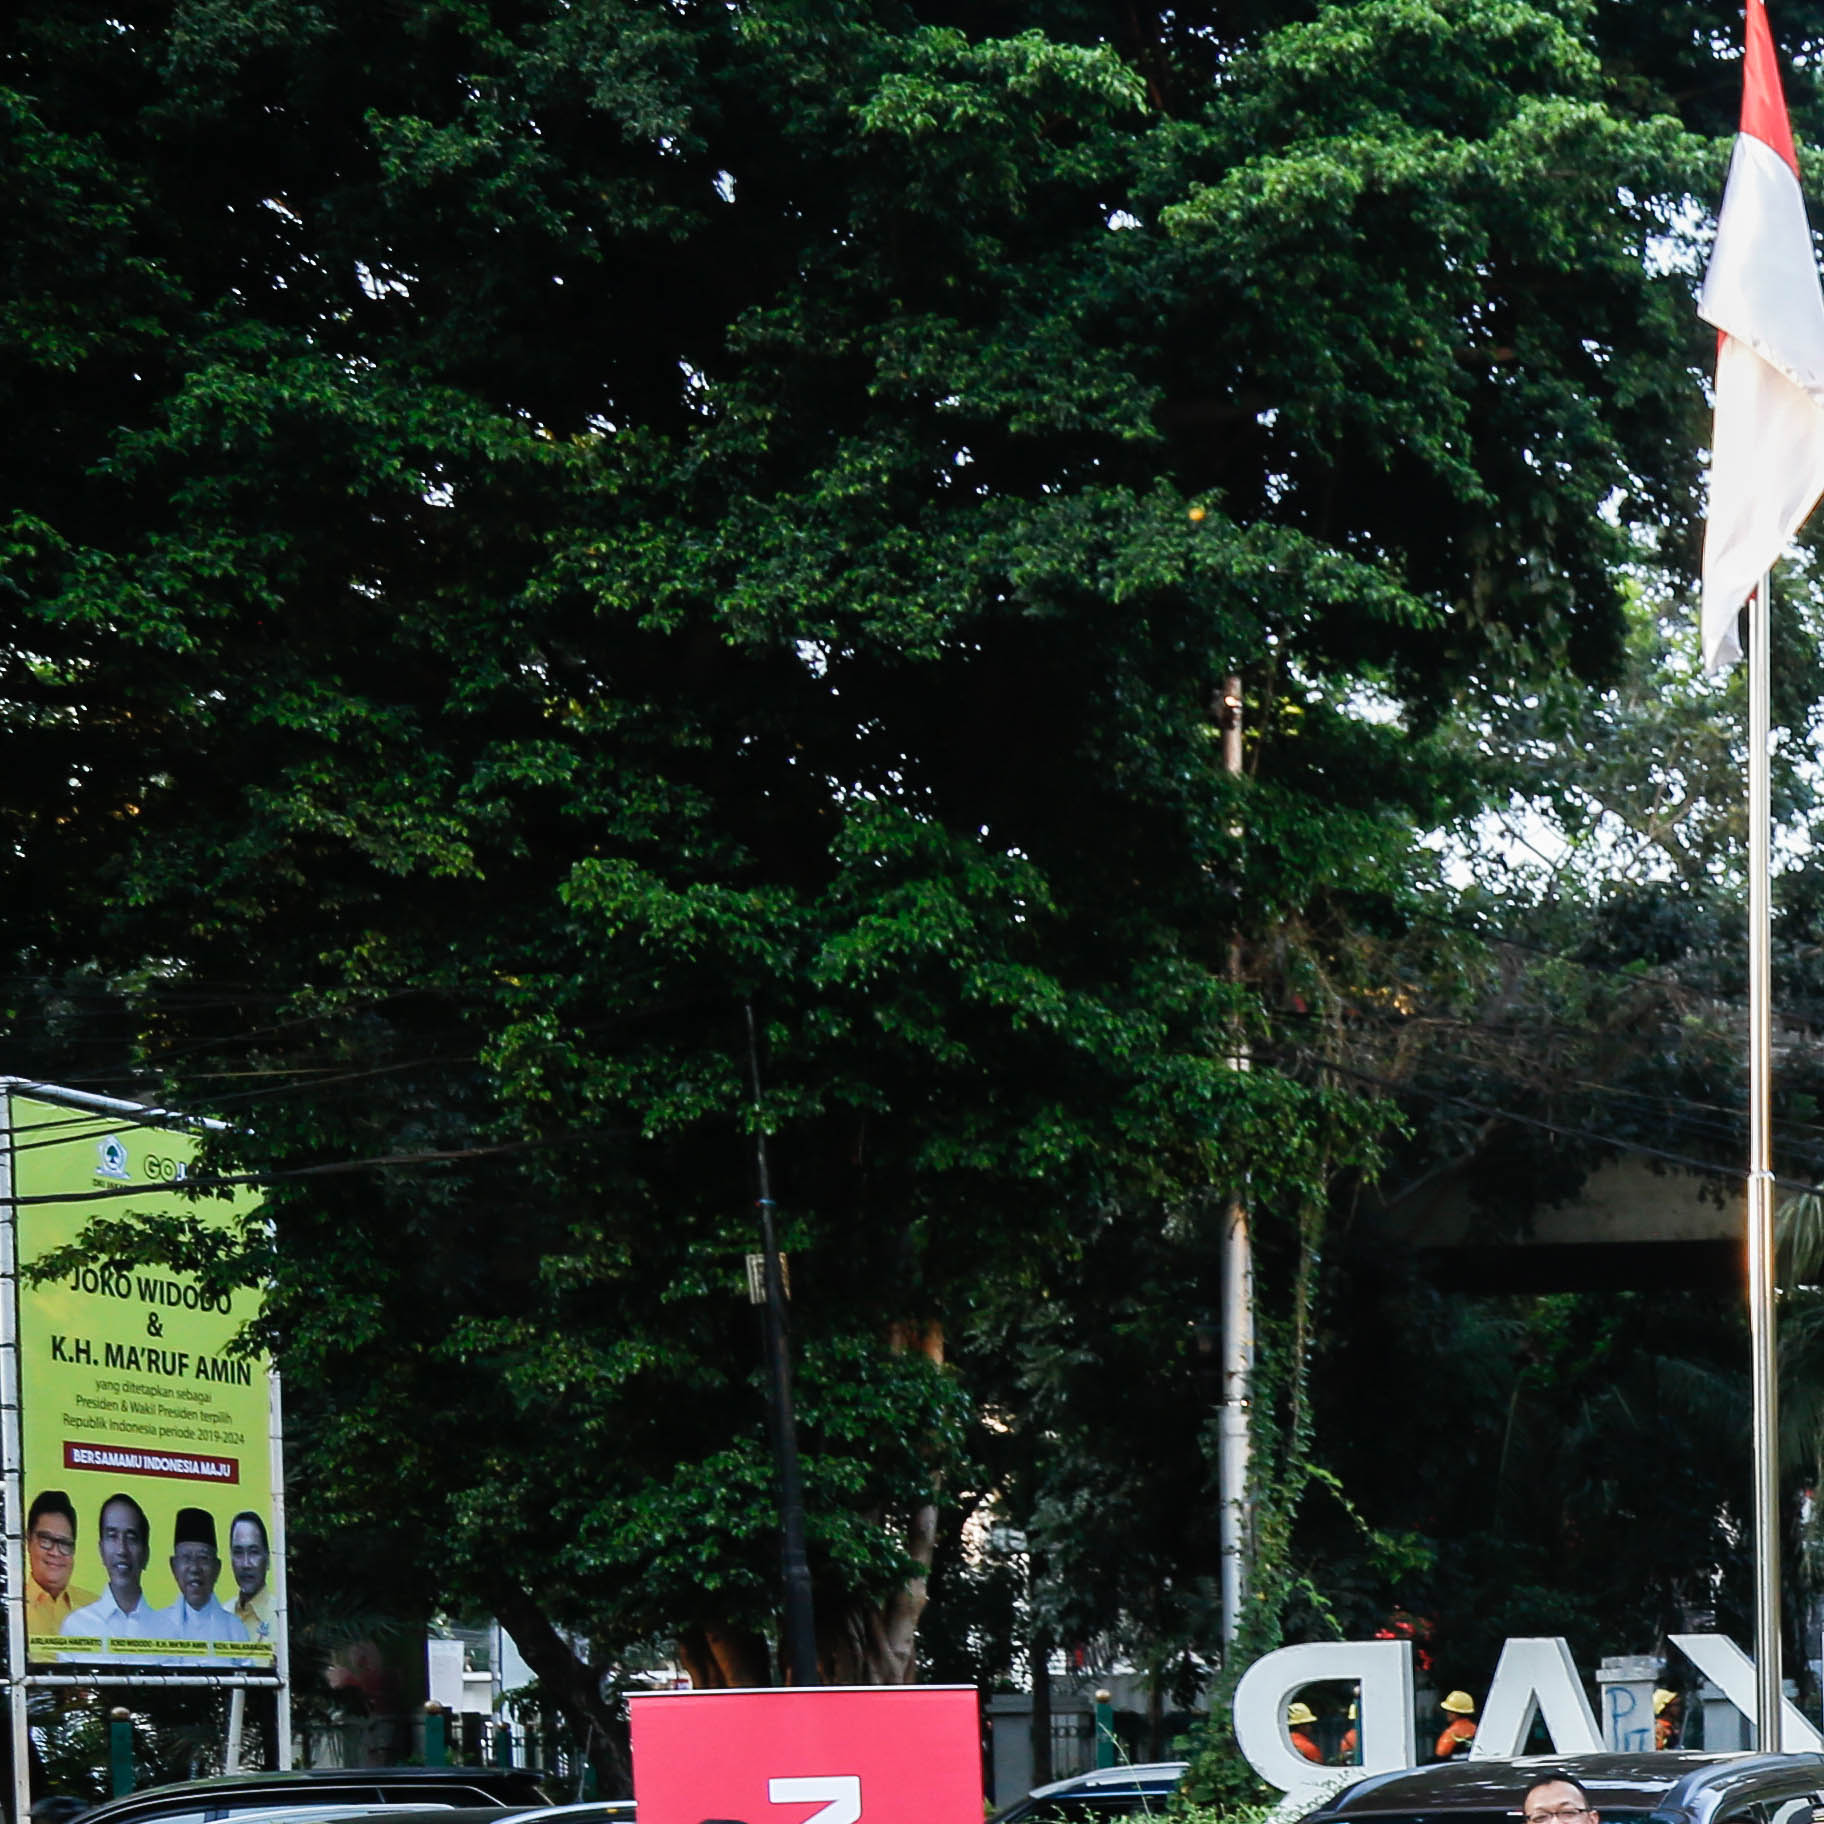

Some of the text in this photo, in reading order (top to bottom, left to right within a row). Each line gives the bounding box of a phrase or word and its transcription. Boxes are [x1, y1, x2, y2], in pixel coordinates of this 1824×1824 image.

[71, 1265, 132, 1300] JOKO
[147, 1312, 163, 1338] &
[52, 1335, 252, 1387] K.H. MA'RUF AMIN
[96, 1380, 212, 1405] yang ditetapkan sebagai
[76, 1394, 232, 1426] Presiden & Wakil Presiden terpilih
[63, 1412, 245, 1445] Republik Indonesia periode 2019-2024
[73, 1448, 231, 1478] BERSAMAMU INDONESIA MAJU
